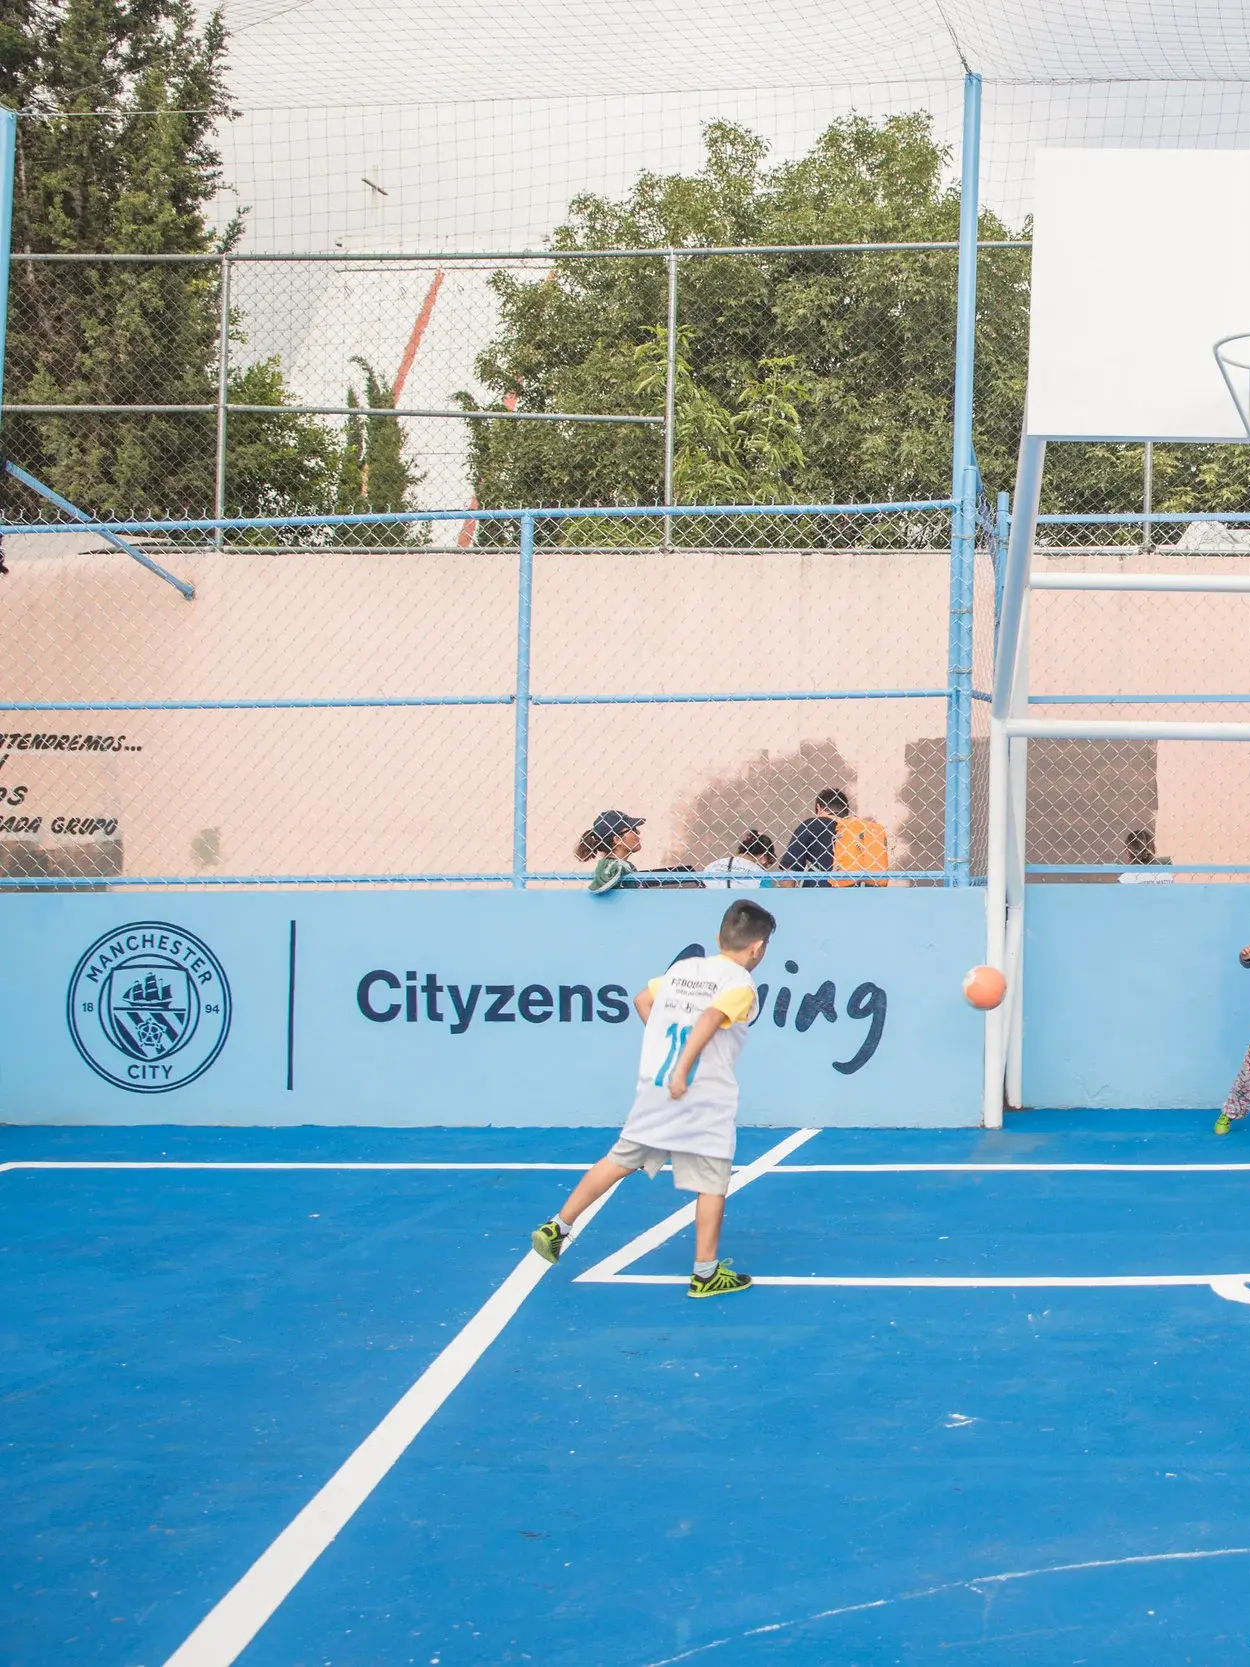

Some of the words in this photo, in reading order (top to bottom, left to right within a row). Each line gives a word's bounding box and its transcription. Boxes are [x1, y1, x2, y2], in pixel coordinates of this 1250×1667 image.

[51, 816, 118, 836] GRUPO
[86, 933, 213, 985] MANCHESTER
[82, 1002, 94, 1012] 18
[205, 1004, 220, 1014] 94
[356, 968, 631, 1035] Cityzens
[127, 1064, 173, 1080] CITY
